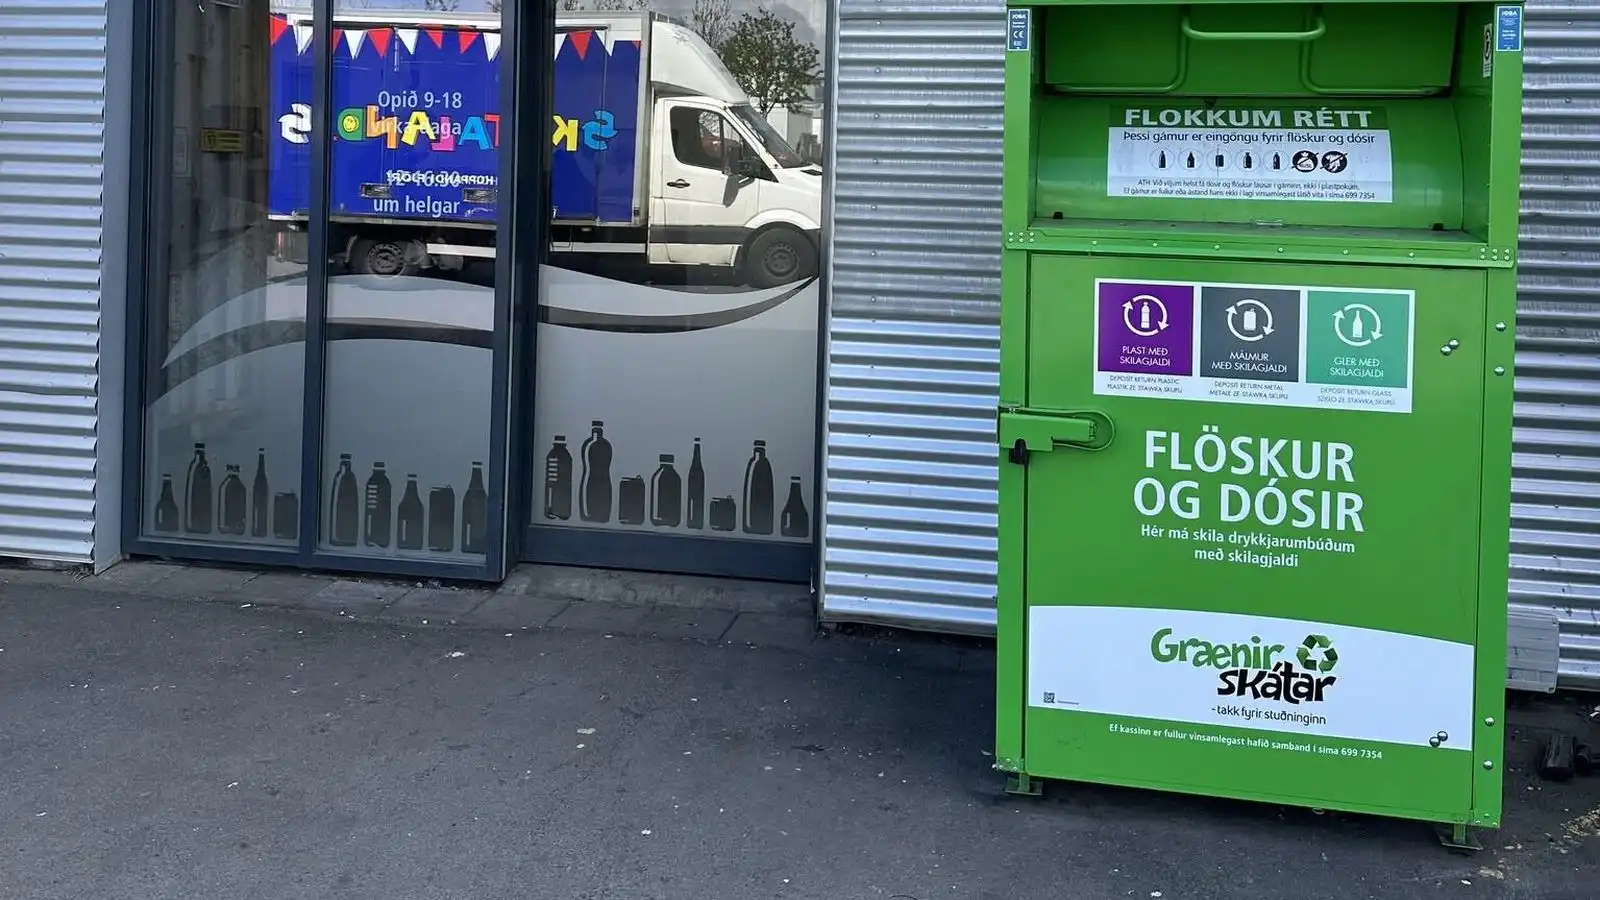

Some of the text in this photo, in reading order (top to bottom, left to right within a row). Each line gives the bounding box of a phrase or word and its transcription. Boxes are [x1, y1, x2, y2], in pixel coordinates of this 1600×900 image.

[378, 90, 462, 112] Opið 9-18
[1124, 106, 1372, 128] FLOKKUM RÉTT
[1123, 131, 1376, 145] Þessi gámur er eingöngu fyrir flöskur og dósir
[1345, 191, 1359, 199] 699
[1359, 192, 1375, 200] 7354
[373, 194, 460, 218] um helgar
[1122, 346, 1168, 356] PLAST MEÐ
[1229, 350, 1269, 362] MÁLMUR
[1119, 356, 1171, 366] SKILAGJALDI
[1211, 361, 1287, 373] MEÐ SKILAGJALDI
[1334, 356, 1380, 367] GLER MEÐ
[1134, 376, 1157, 384] RETURN
[1329, 367, 1384, 378] SKILAGJALDI
[1240, 382, 1263, 390] RETURN
[1144, 424, 1355, 483] FLÖSKUR
[1133, 477, 1365, 533] OG DÓSIR
[1141, 523, 1356, 553] Hér má skila drykkjarumbúðum
[1194, 546, 1299, 568] með skilagjaldi
[1216, 660, 1337, 705] skátar
[1241, 706, 1263, 720] fyrir
[1264, 709, 1327, 727] stuðninginn
[1109, 723, 1118, 732] Ef
[1119, 724, 1151, 736] kassinn
[1153, 729, 1162, 737] er
[1163, 728, 1188, 740] fullur
[1189, 731, 1245, 746] vinsamlegast
[1247, 736, 1269, 748] hafið
[1271, 740, 1311, 753] samband
[1341, 747, 1358, 757] 699
[1360, 749, 1383, 759] 7354
